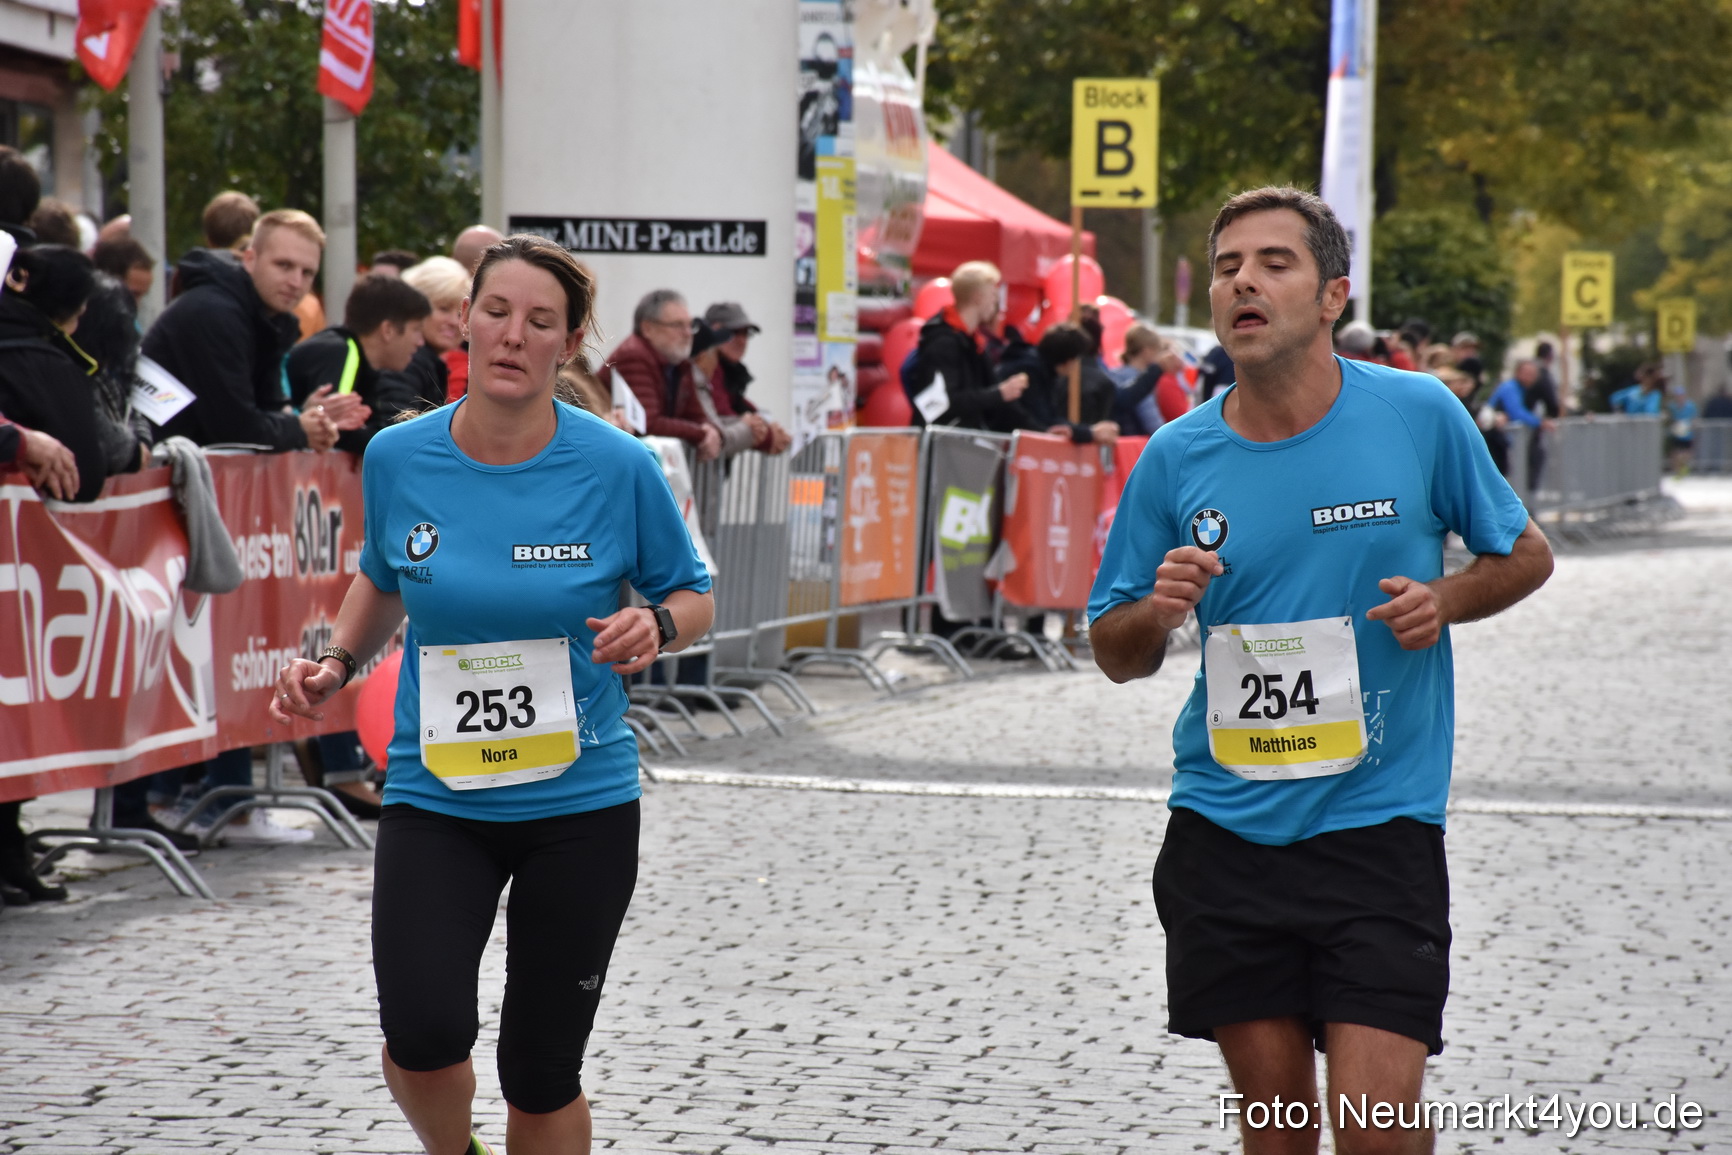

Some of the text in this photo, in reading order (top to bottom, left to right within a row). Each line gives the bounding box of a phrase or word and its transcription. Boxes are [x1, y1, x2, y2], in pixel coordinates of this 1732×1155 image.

[1084, 86, 1147, 108] Block
[1097, 119, 1134, 177] B
[1575, 275, 1599, 309] C
[1312, 499, 1398, 527] BOCK
[1312, 518, 1401, 535] inspired by smart concepts
[513, 544, 590, 561] BOCK
[511, 562, 538, 570] inspired
[538, 562, 547, 570] by
[567, 561, 594, 570] concepts
[1255, 637, 1303, 653] BOCK
[472, 654, 523, 670] BOCK
[1239, 670, 1319, 720] 254
[456, 685, 536, 733] 253
[1213, 714, 1219, 723] B
[428, 729, 434, 738] B
[1249, 735, 1317, 753] Matthias
[481, 748, 518, 763] Nora
